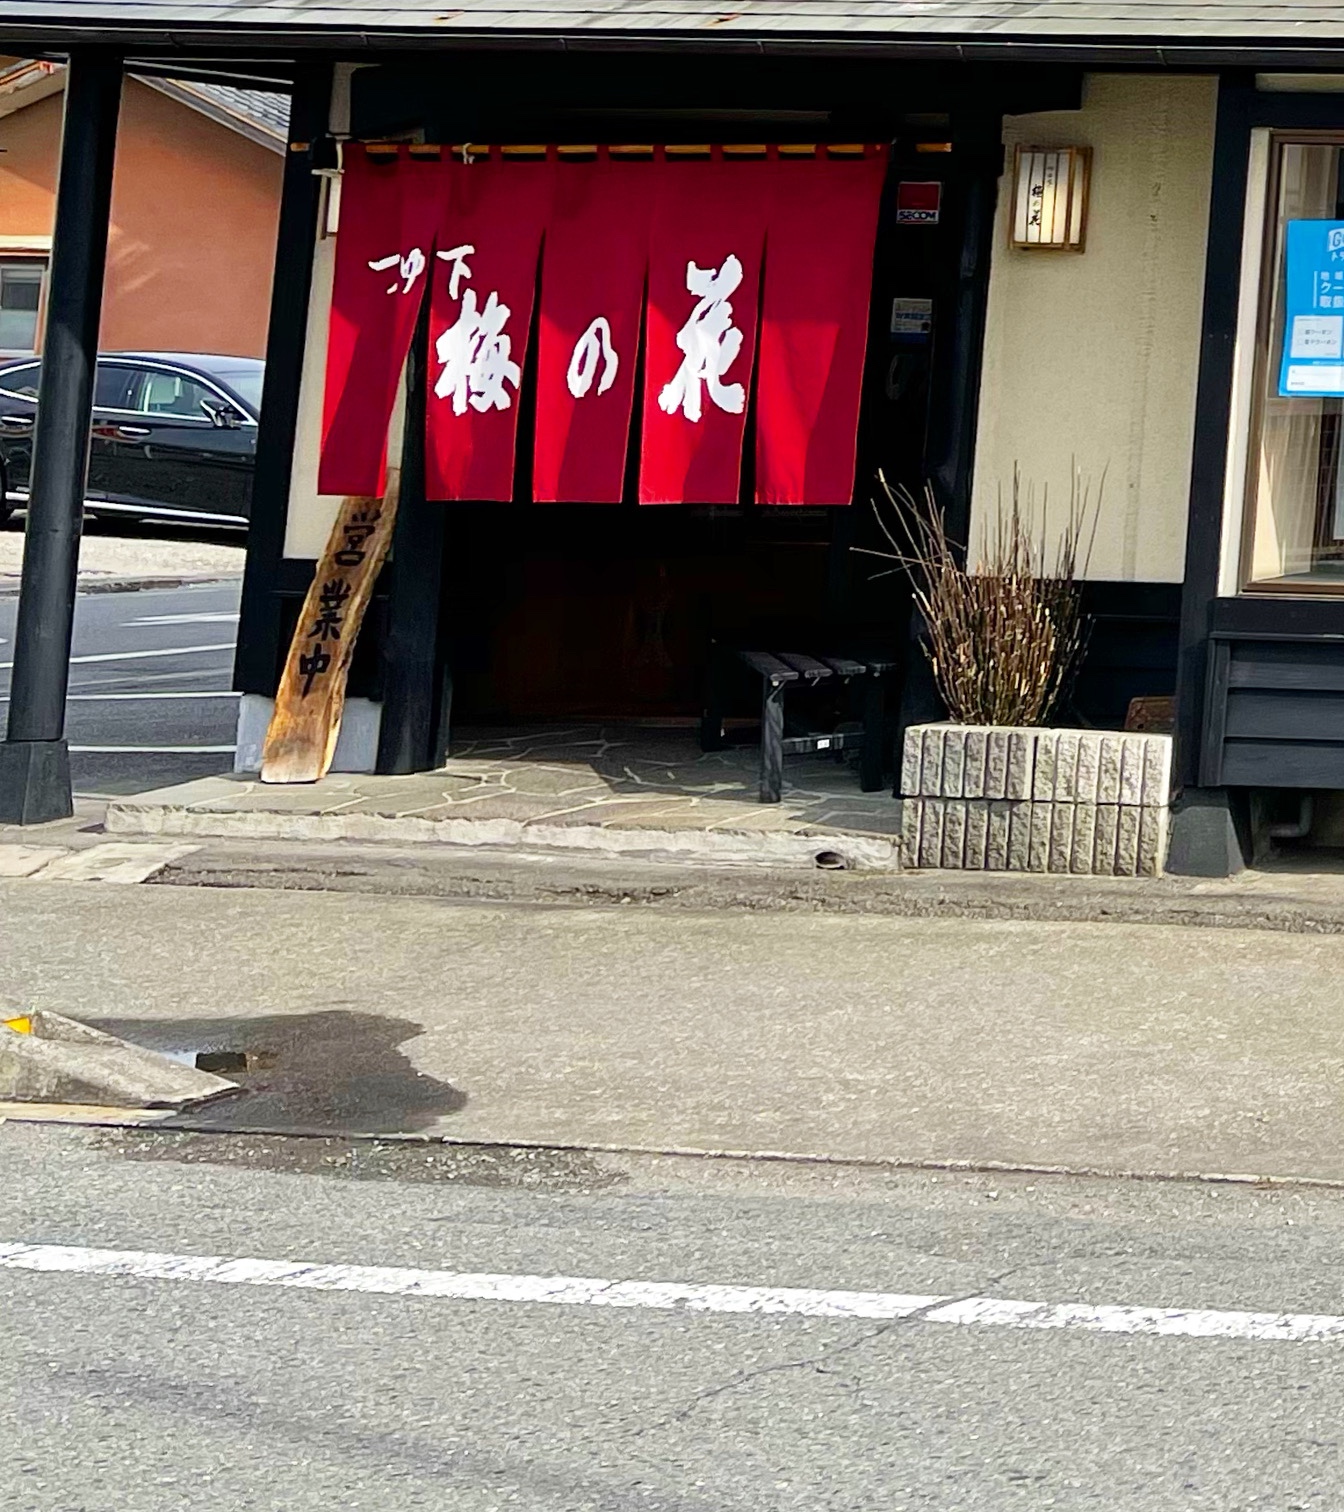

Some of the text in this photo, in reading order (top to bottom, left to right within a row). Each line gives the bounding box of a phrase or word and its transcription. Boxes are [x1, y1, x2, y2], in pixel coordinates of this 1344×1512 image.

[899, 210, 937, 221] SECOM
[434, 254, 746, 424] 梅の花
[300, 508, 382, 700] 営業中
